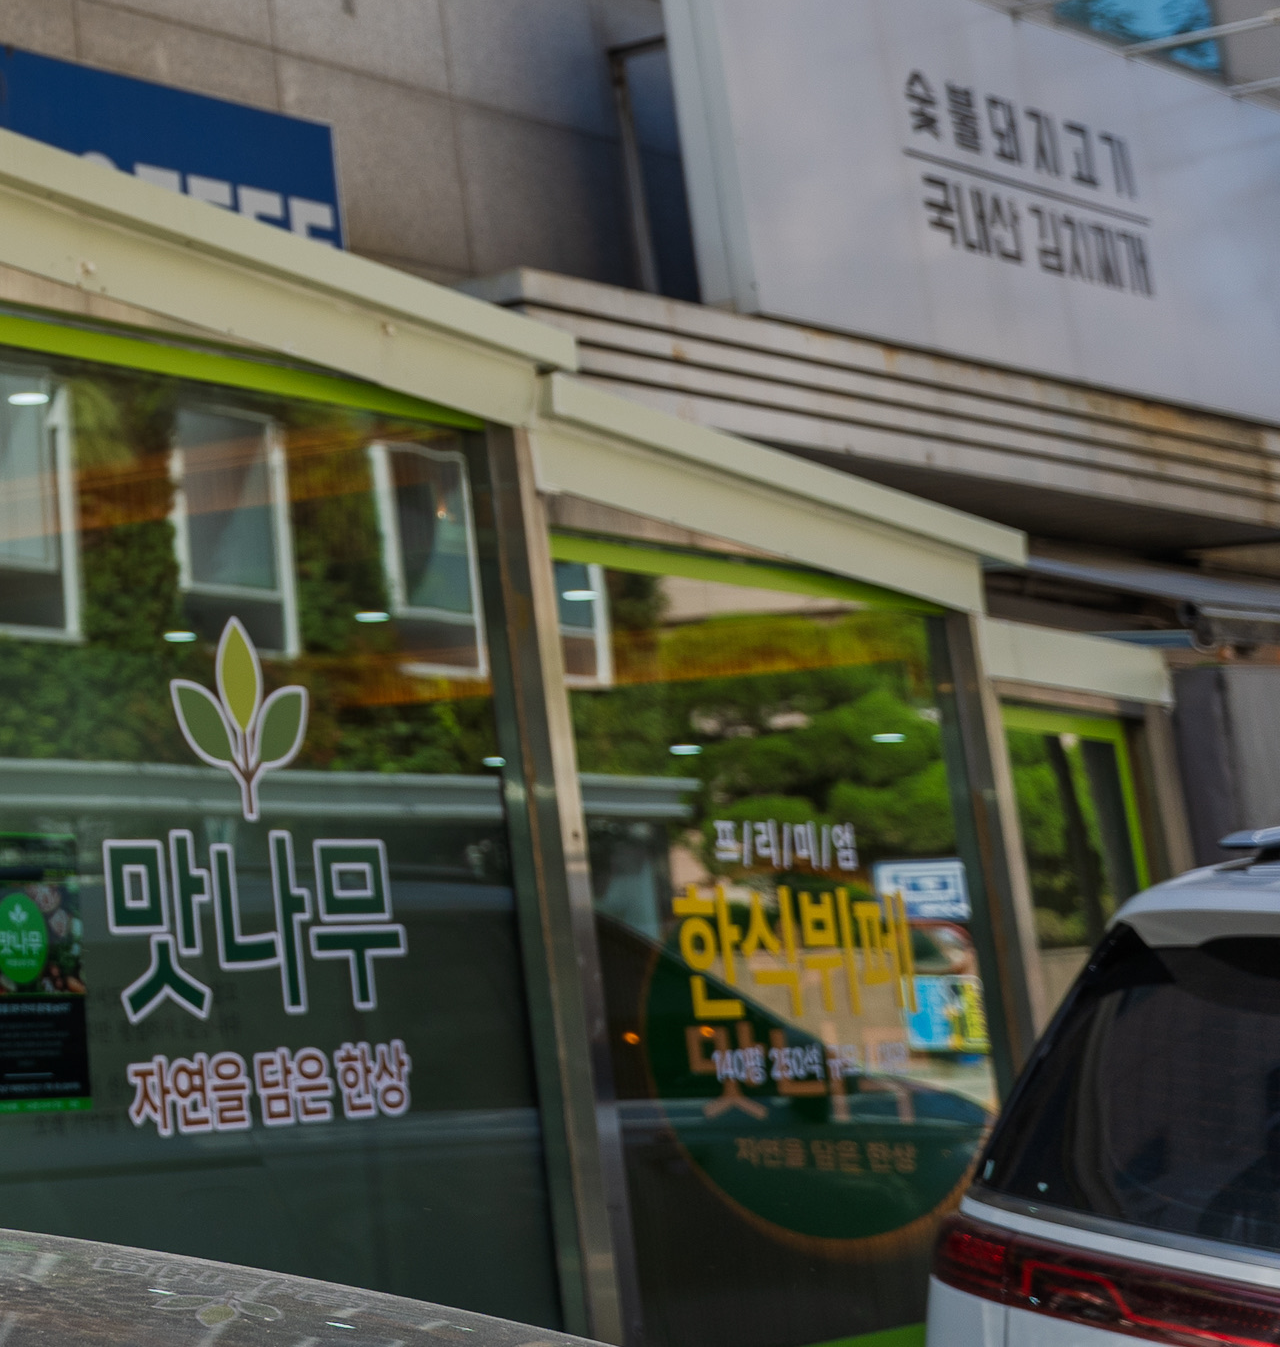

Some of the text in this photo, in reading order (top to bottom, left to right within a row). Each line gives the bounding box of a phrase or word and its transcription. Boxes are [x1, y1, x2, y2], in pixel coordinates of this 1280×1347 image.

[921, 171, 1156, 300] 국내산 김치찌개
[102, 829, 407, 1024] 맛나무
[672, 883, 917, 1019] 한식뷔페
[127, 1039, 412, 1137] 자연을 담은 한상
[735, 1136, 918, 1173] 자연을 담은 한상
